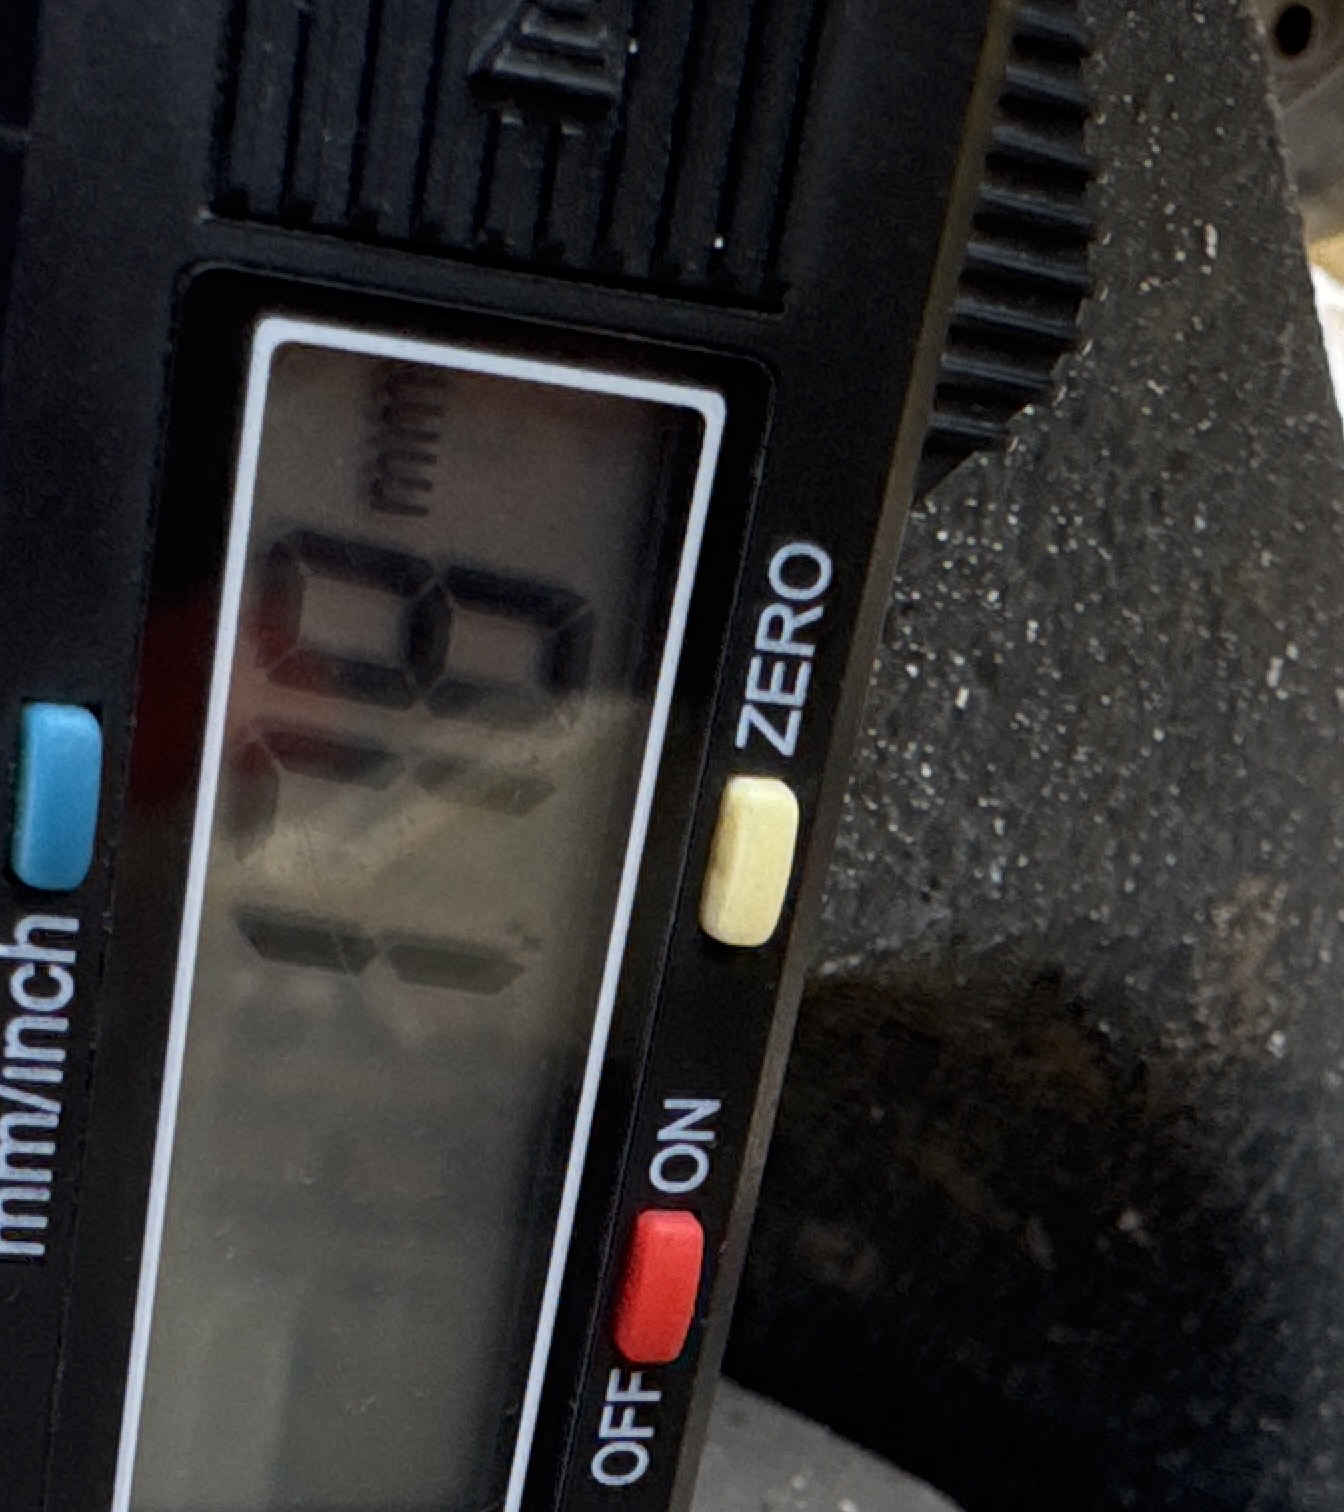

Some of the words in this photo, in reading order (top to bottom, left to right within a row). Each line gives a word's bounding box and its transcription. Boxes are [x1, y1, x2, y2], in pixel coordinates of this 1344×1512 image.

[358, 364, 446, 518] mm
[735, 540, 833, 758] ZERO
[650, 1098, 721, 1194] ON
[591, 1369, 661, 1488] OFF
